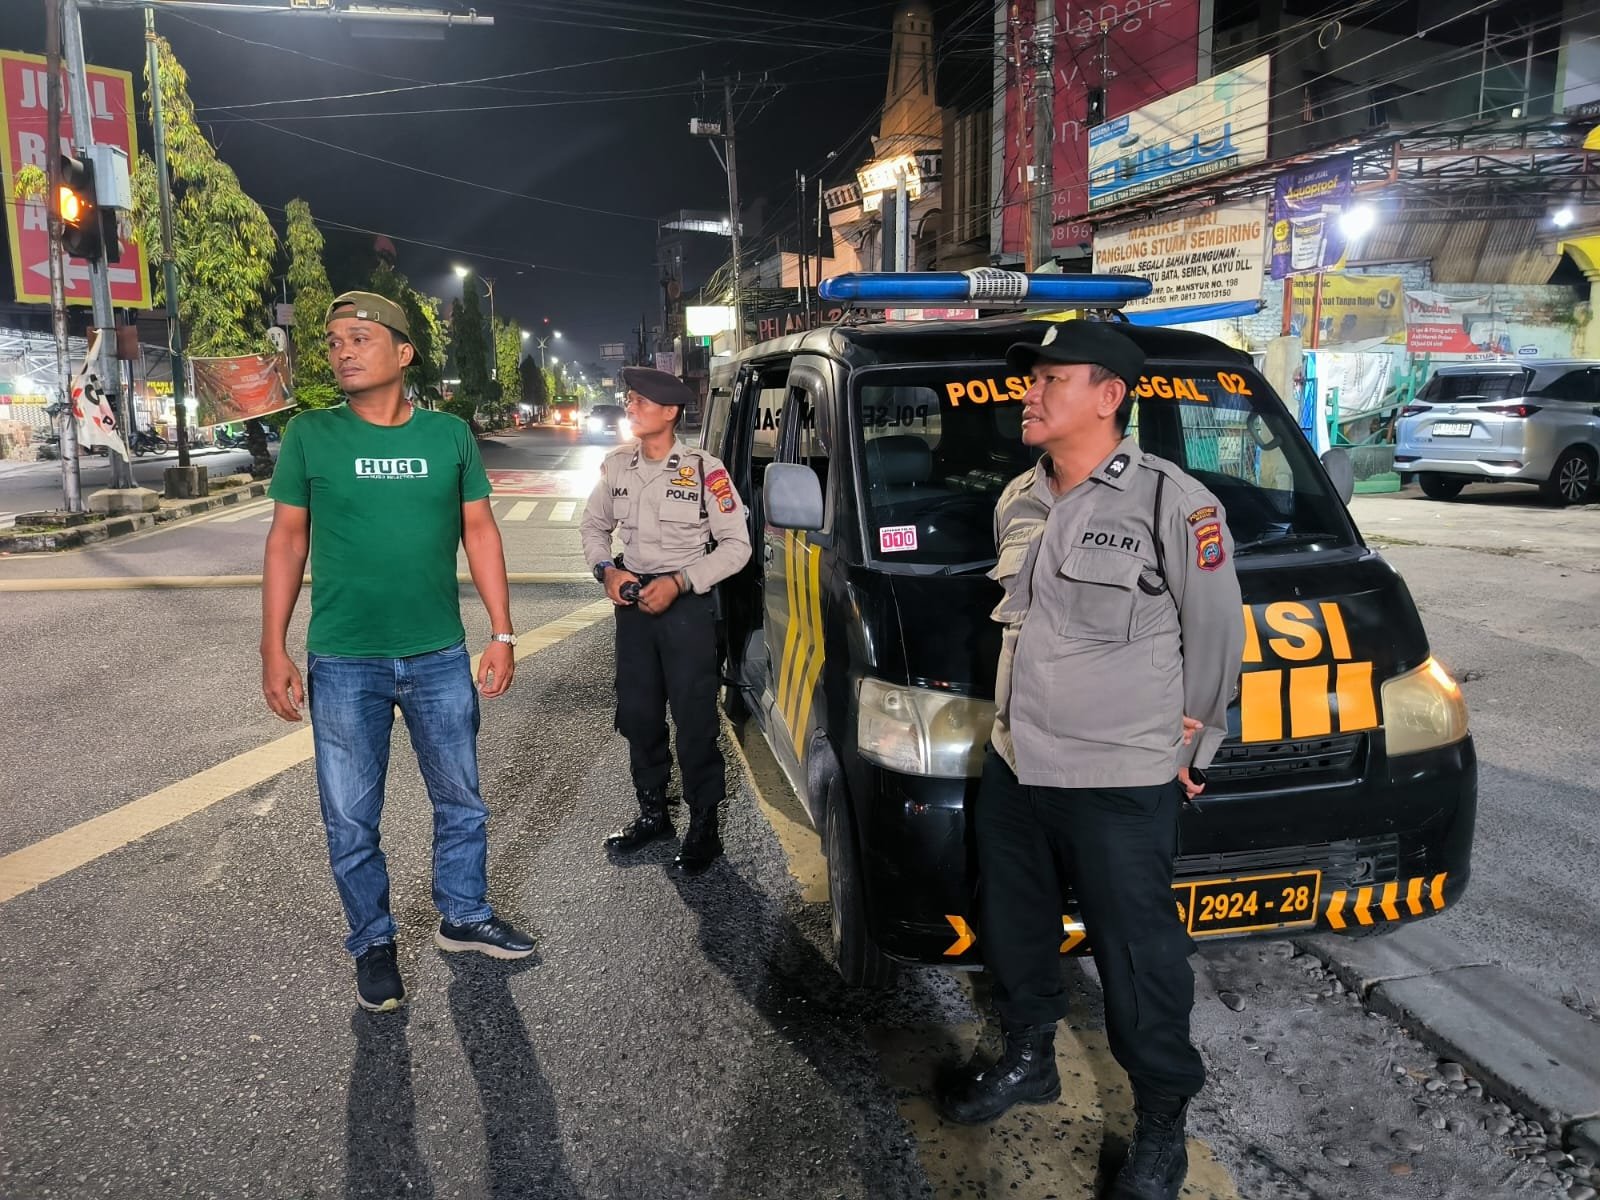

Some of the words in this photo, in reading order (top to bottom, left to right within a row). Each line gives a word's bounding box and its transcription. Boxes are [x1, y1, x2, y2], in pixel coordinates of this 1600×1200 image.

[20, 69, 114, 120] JUL
[1128, 219, 1180, 240] MARIKE
[1096, 241, 1148, 264] PANGLONG
[1190, 221, 1261, 249] SEMBIRING
[1137, 257, 1165, 272] SEGALA
[1190, 247, 1237, 265] BANGUNAN
[1161, 269, 1180, 281] BATA,
[1182, 264, 1210, 278] SEMEN,
[1211, 261, 1234, 275] KAYU
[1235, 258, 1253, 272] DLL.
[1211, 280, 1224, 289] NO.
[1130, 375, 1210, 402] GGAL
[1215, 370, 1254, 396] 02
[360, 459, 423, 474] HUGO
[665, 489, 699, 502] POLRI
[882, 531, 915, 548] 110
[1081, 531, 1141, 553] POLRI
[1198, 890, 1259, 921] 2924
[1279, 886, 1310, 913] 28
